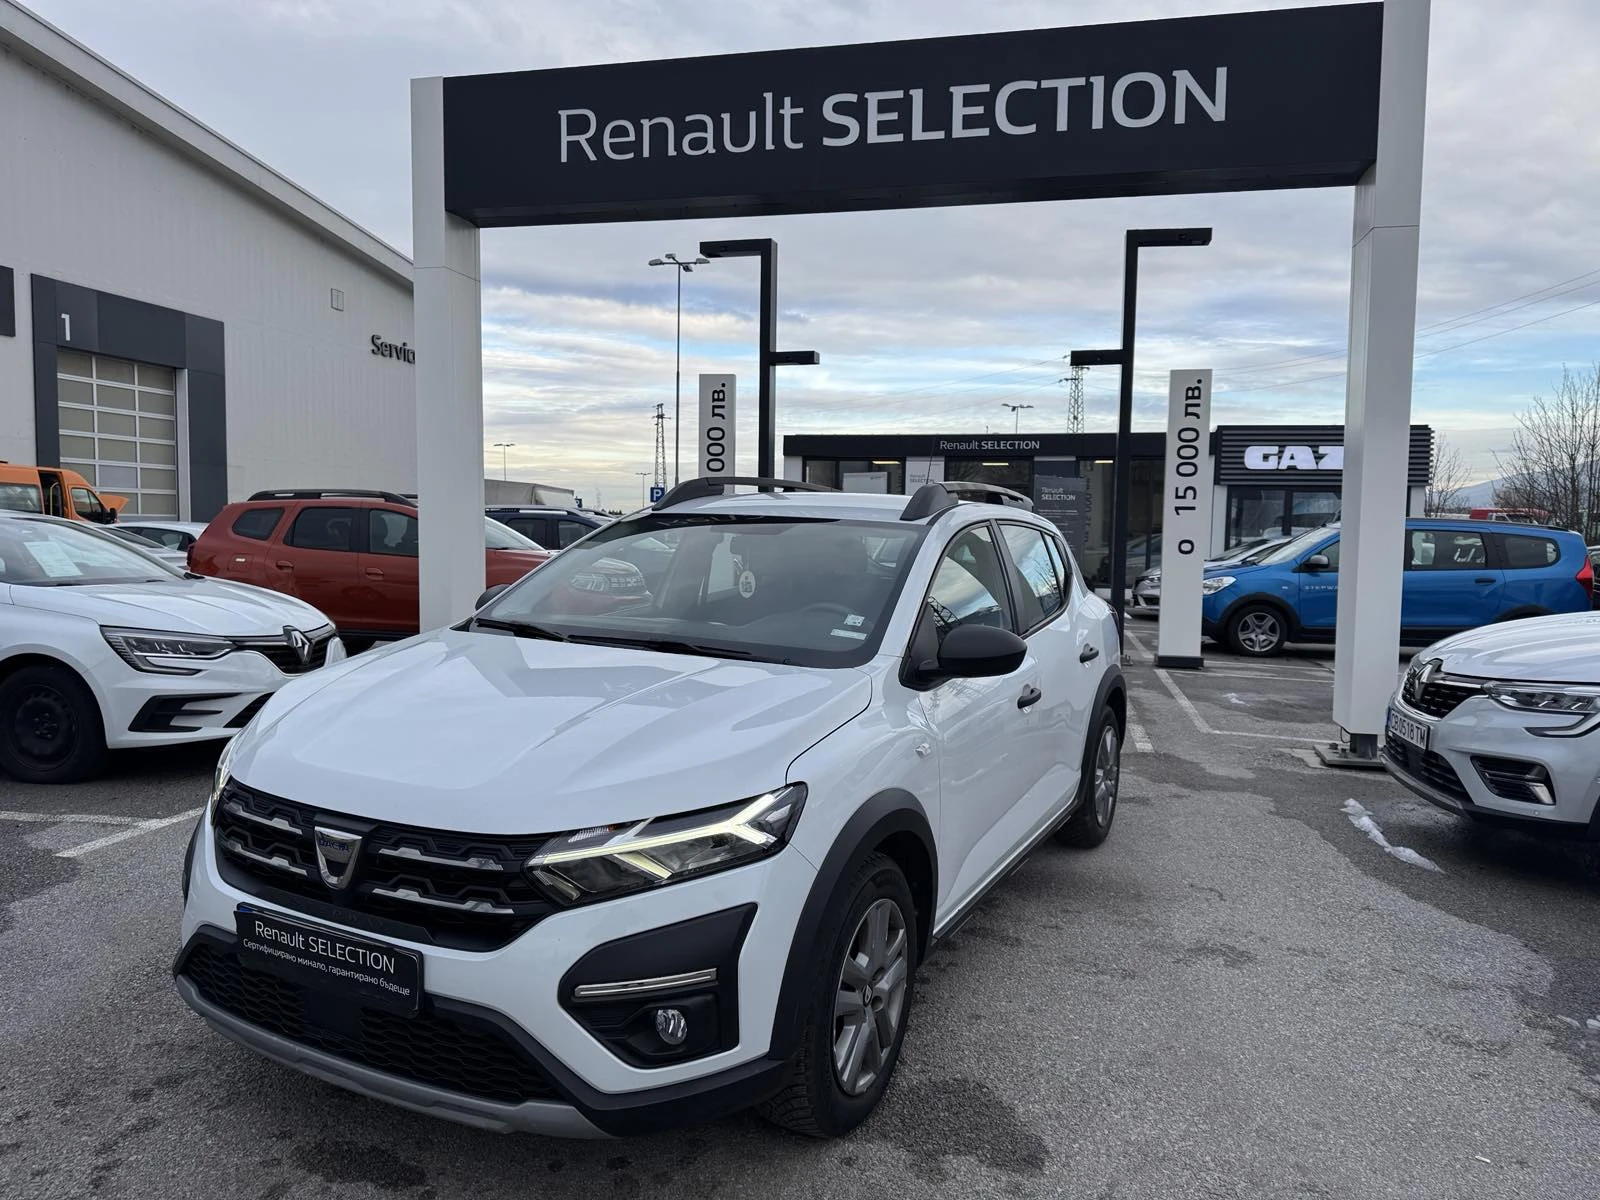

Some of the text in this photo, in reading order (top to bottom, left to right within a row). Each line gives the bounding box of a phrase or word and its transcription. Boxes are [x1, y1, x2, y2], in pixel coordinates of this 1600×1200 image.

[558, 66, 1228, 163] Renault SELECTION
[61, 313, 71, 341] 1
[371, 334, 415, 365] Servic
[1184, 378, 1203, 420] лв.
[706, 382, 726, 473] 000 лв.
[939, 439, 1040, 450] Renault SELECTION
[1175, 427, 1200, 478] 000
[653, 488, 662, 501] P
[1174, 485, 1197, 516] 15
[243, 938, 411, 997] Сертифицирано минало, гарантирано бъдеще
[255, 920, 305, 950] Renault
[308, 936, 395, 974] SELECTION
